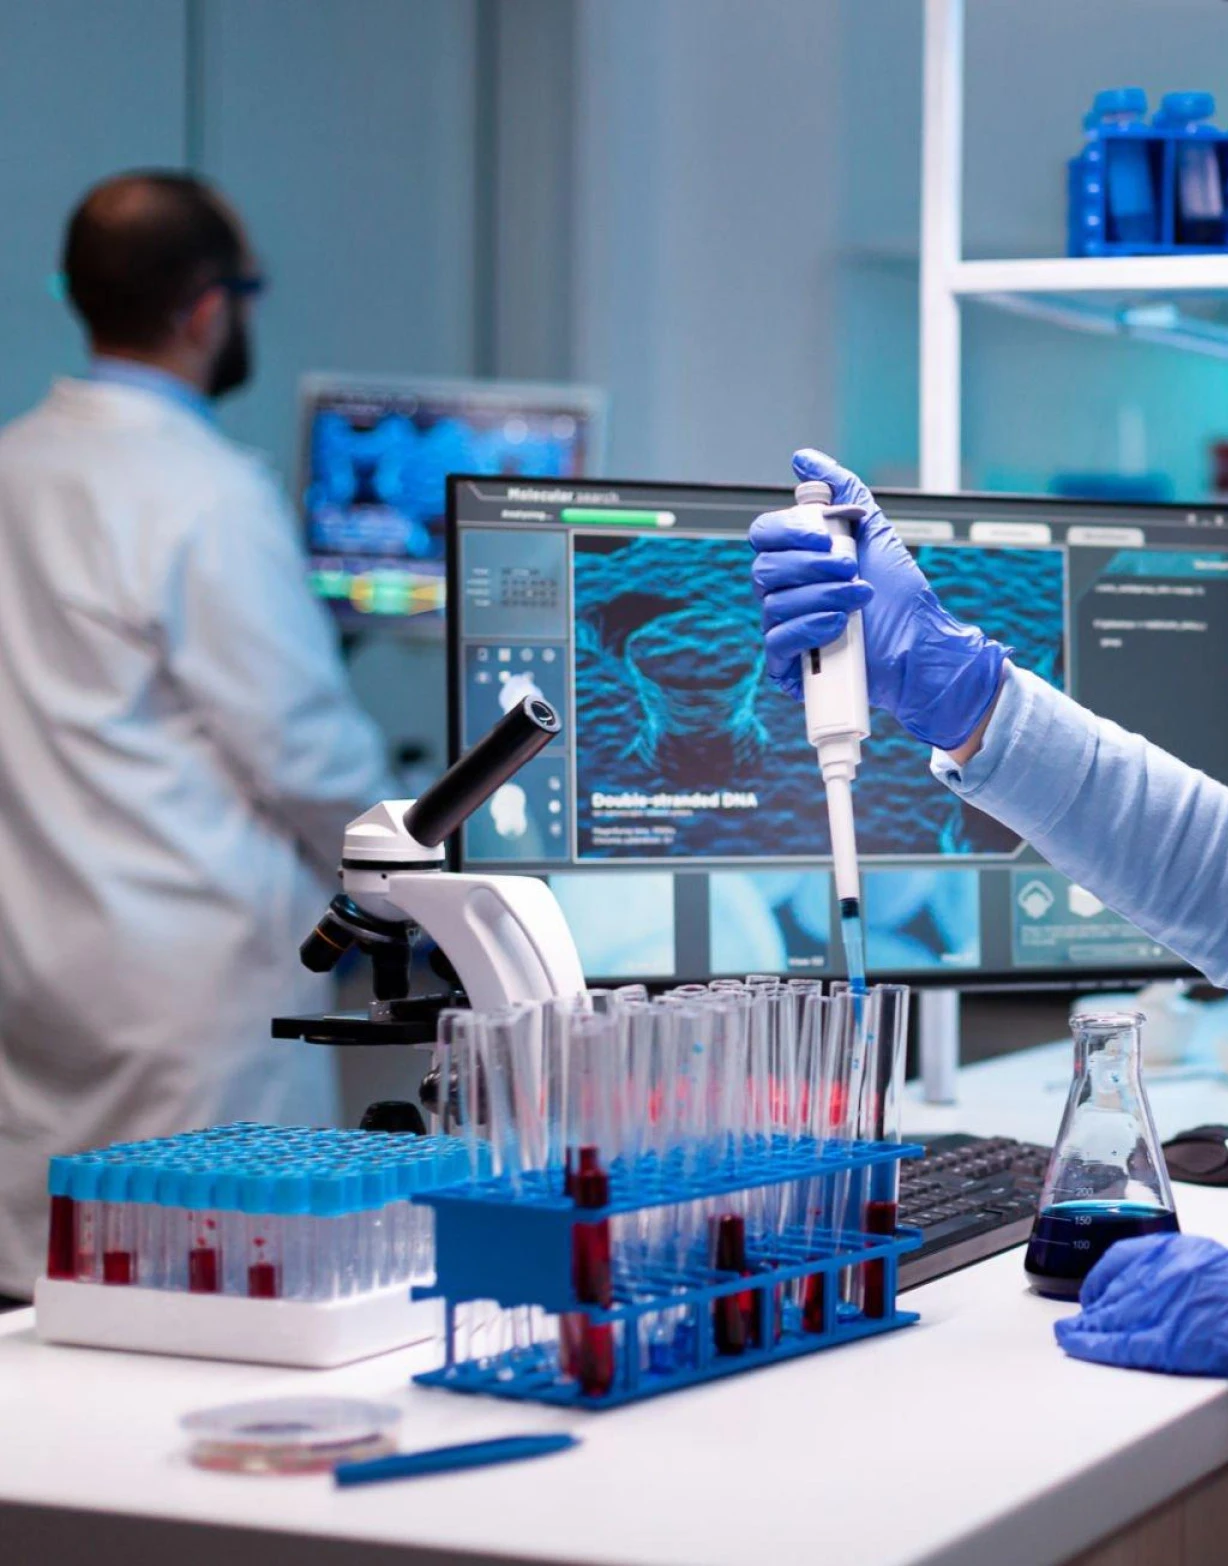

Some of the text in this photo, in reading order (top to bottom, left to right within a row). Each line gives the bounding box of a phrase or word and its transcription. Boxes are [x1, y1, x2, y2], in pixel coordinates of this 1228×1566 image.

[507, 487, 574, 502] Molecular
[591, 791, 758, 809] Double-stranded DNA
[1075, 1187, 1094, 1197] 200
[1074, 1215, 1092, 1225] 150
[1072, 1240, 1090, 1250] 100
